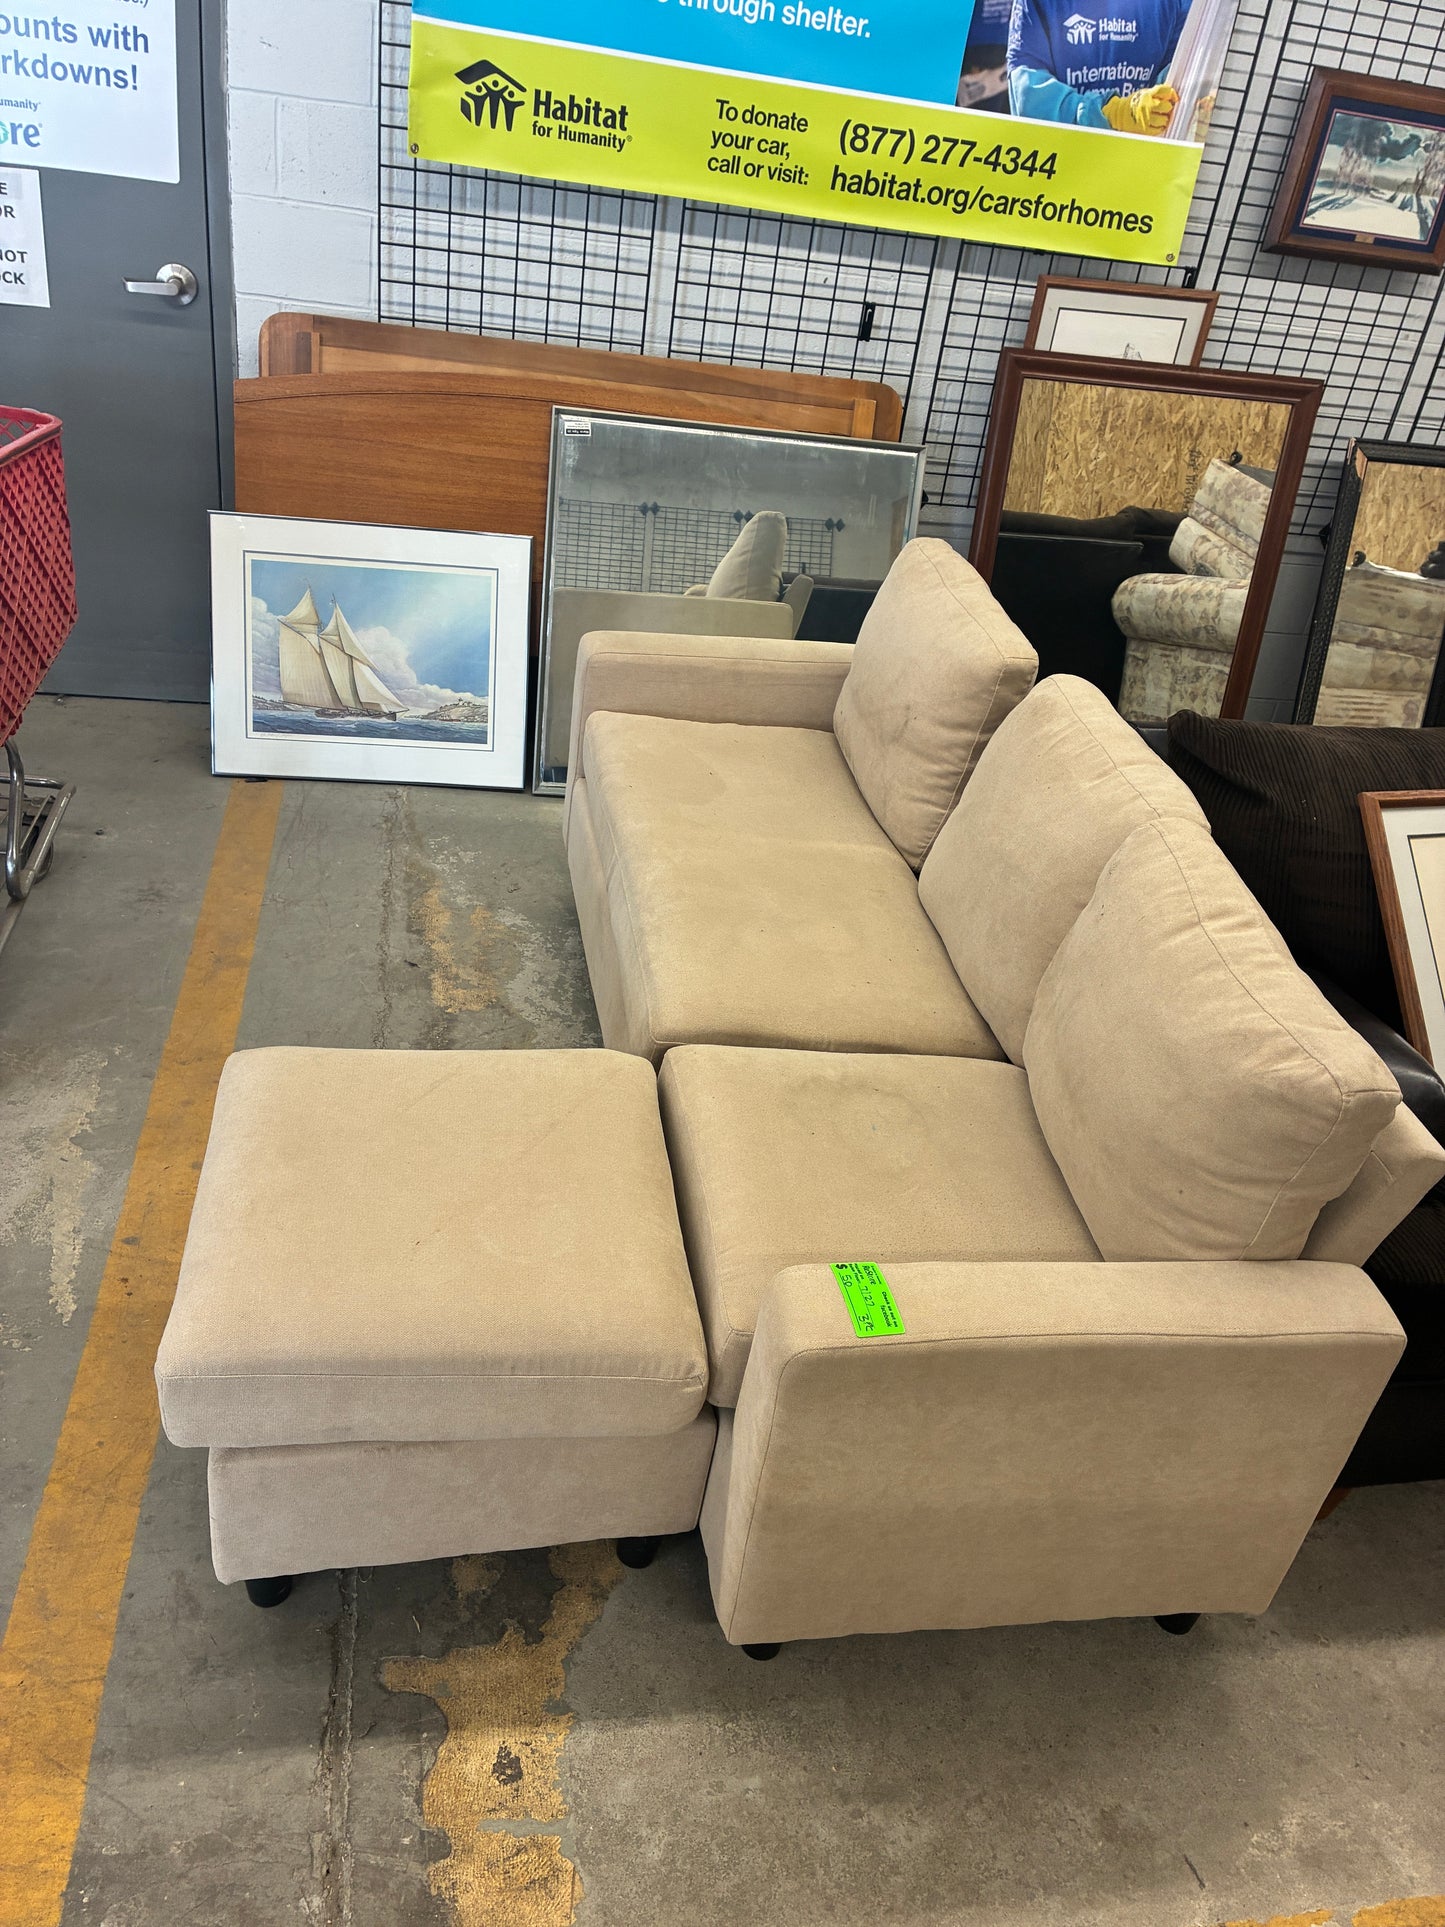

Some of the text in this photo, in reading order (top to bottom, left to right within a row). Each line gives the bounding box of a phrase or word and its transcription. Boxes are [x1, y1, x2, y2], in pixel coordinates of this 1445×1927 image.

[781, 1, 871, 38] shelter.
[1099, 18, 1137, 32] Habitat
[88, 23, 149, 53] with
[1099, 33, 1108, 41] for
[1, 49, 138, 90] rkdowns!
[1066, 62, 1154, 85] International
[533, 89, 628, 131] Habitat
[715, 99, 809, 133] To donate
[532, 120, 553, 137] for
[711, 129, 791, 160] your car,
[839, 119, 1057, 180] (877) 277-4344
[707, 155, 809, 185] call or visit:
[830, 164, 1154, 234] habitat.org/carsforhomes
[0, 271, 25, 285] CK
